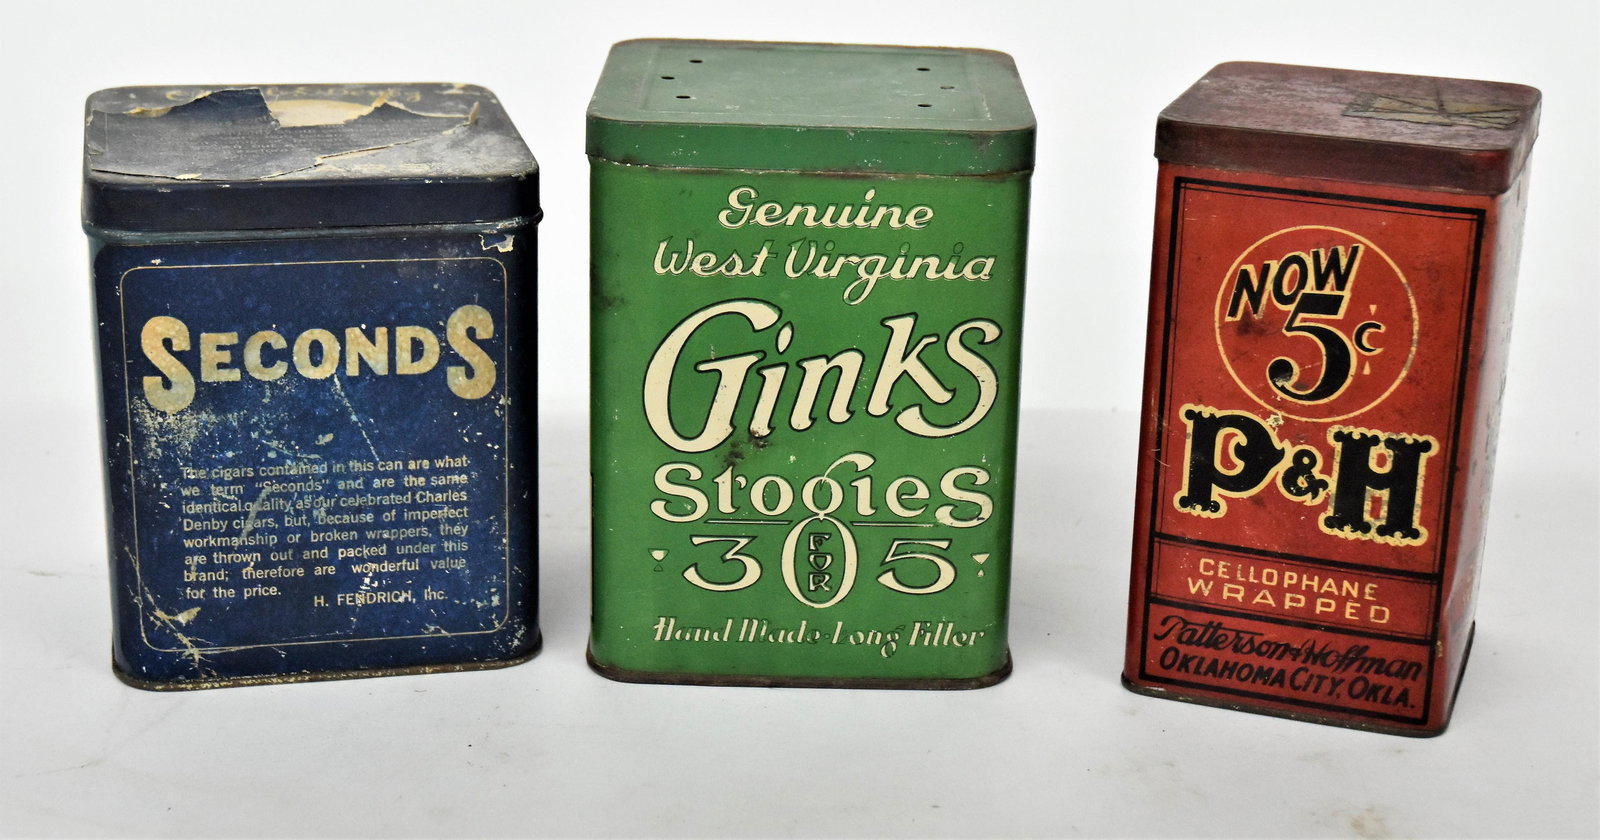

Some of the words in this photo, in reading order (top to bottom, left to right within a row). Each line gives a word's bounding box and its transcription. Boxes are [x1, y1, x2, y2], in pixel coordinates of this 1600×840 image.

[717, 184, 935, 230] Genuine
[652, 235, 779, 278] West
[784, 237, 997, 305] Virginia
[1224, 243, 1364, 322] NOW
[141, 304, 497, 415] SECONDS
[642, 297, 1003, 453] Ginks
[181, 465, 206, 479] The
[212, 466, 255, 481] cigars
[259, 461, 328, 476] contained
[332, 461, 345, 473] in
[349, 459, 374, 472] this
[378, 460, 403, 471] can
[407, 459, 430, 471] are
[434, 455, 468, 468] what
[180, 486, 200, 496] we
[211, 484, 243, 497] term
[338, 478, 363, 490] and
[373, 478, 395, 488] are
[404, 475, 426, 487] the
[431, 474, 468, 486] same
[182, 500, 241, 514] identical
[295, 499, 311, 509] as
[313, 498, 335, 509] our
[340, 491, 411, 507] celebrated
[416, 490, 467, 504] Charles
[183, 517, 228, 532] Denby
[284, 514, 310, 528] but,
[318, 511, 374, 526] because
[382, 509, 397, 522] of
[403, 507, 468, 522] imperfect
[183, 533, 278, 549] workmanship
[287, 534, 301, 543] or
[310, 529, 358, 543] broken
[366, 526, 432, 541] wrappers,
[440, 524, 468, 537] they
[184, 556, 207, 565] are
[213, 551, 261, 565] thrown
[270, 549, 294, 561] out
[303, 547, 328, 559] and
[338, 544, 387, 560] packed
[396, 542, 436, 554] under
[443, 540, 468, 552] this
[681, 534, 763, 592] 3
[808, 532, 833, 592] FOR
[876, 538, 957, 595] 5
[184, 568, 229, 582] brand;
[242, 565, 305, 580] therefore
[314, 565, 336, 576] are
[352, 559, 419, 574] wonderful
[430, 556, 466, 570] value
[1200, 558, 1378, 601] CELLOPHANE
[186, 587, 206, 599] for
[213, 587, 235, 599] the
[244, 584, 282, 599] price.
[314, 595, 329, 607] H.
[337, 589, 416, 605] FENDRICH,
[424, 587, 448, 601] Inc.
[1187, 577, 1390, 624] WRAPPED
[653, 616, 735, 642] Hand
[907, 621, 985, 647] Filler
[1160, 646, 1286, 688] OKLAHOMA
[1289, 667, 1344, 699] CITY,
[1347, 676, 1415, 709] OKLA.
